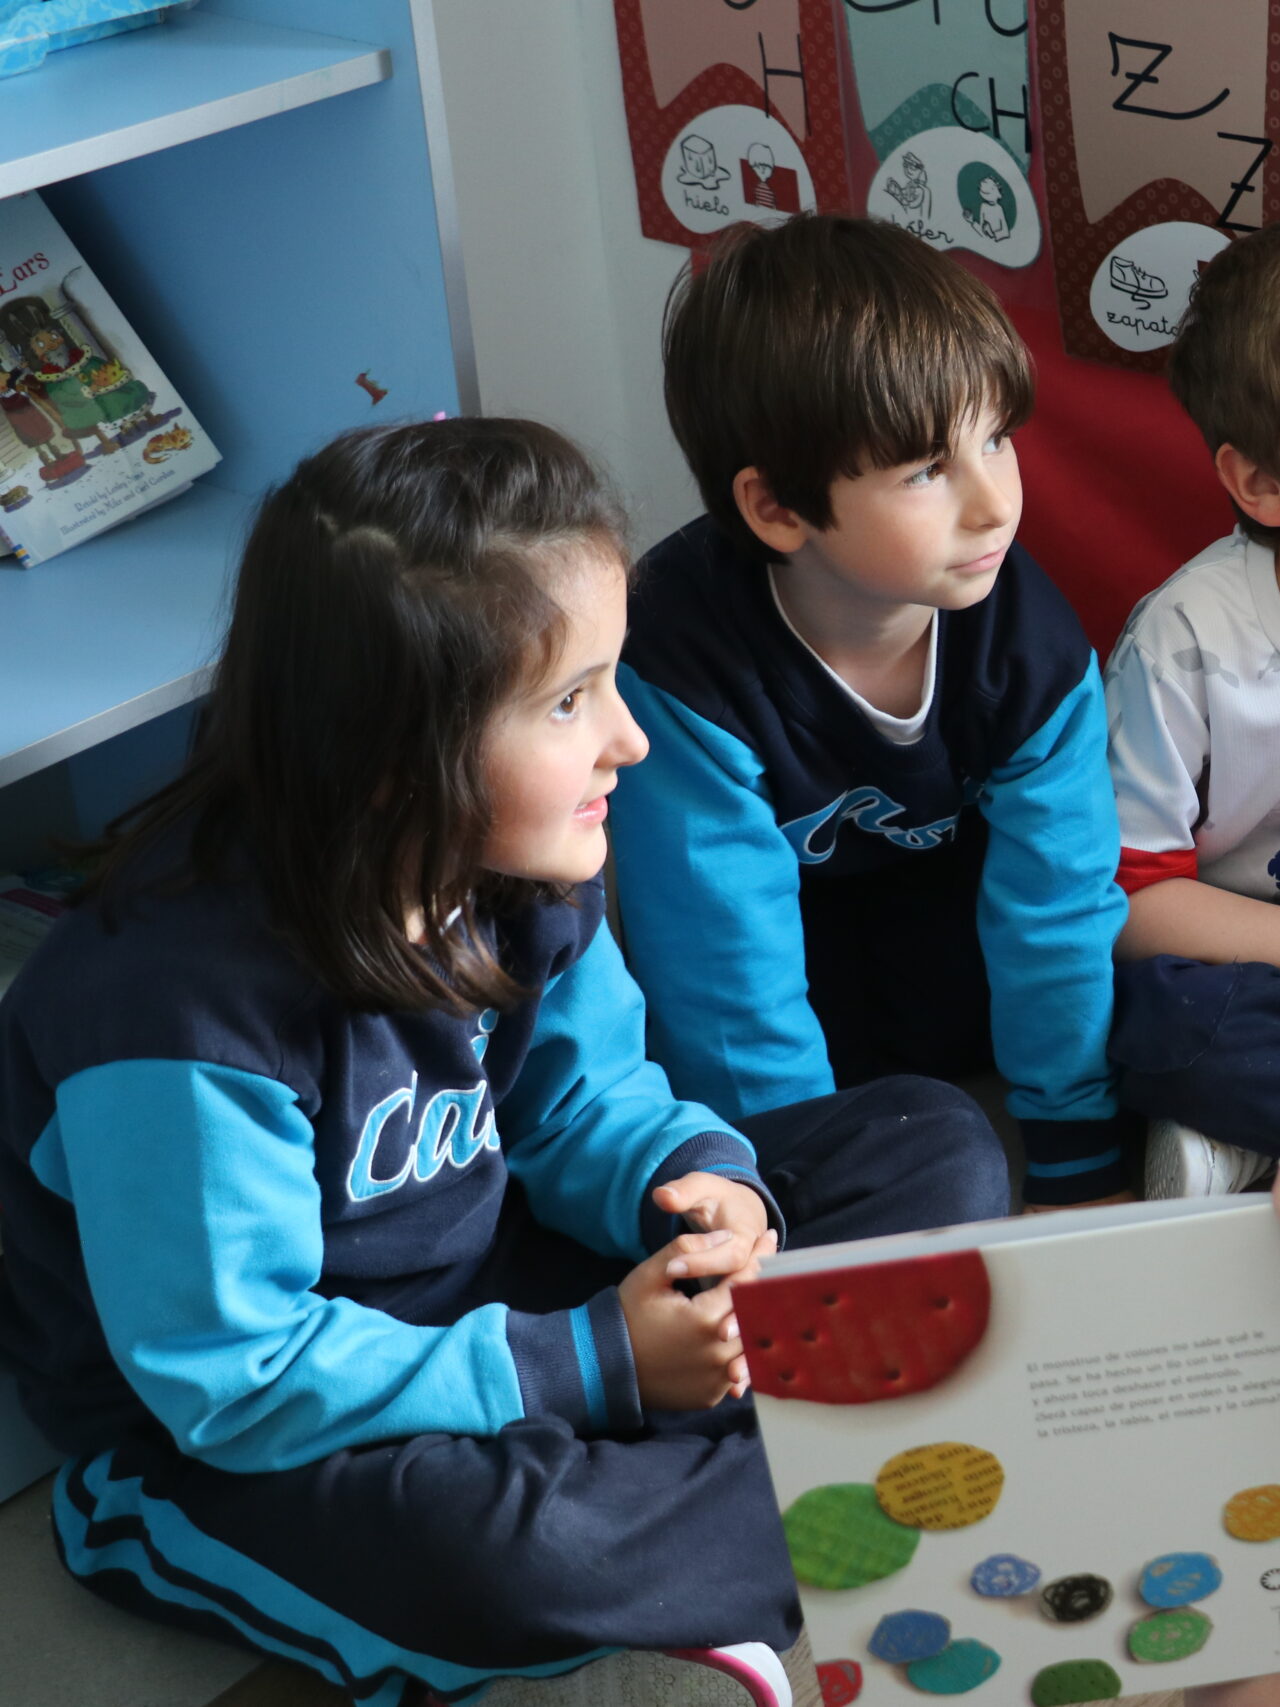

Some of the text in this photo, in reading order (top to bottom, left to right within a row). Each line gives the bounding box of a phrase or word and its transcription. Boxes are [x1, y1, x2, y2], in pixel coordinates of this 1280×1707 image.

[758, 32, 812, 137] H
[951, 71, 1032, 153] CH
[683, 189, 730, 216] hielo
[1217, 131, 1273, 232] Z
